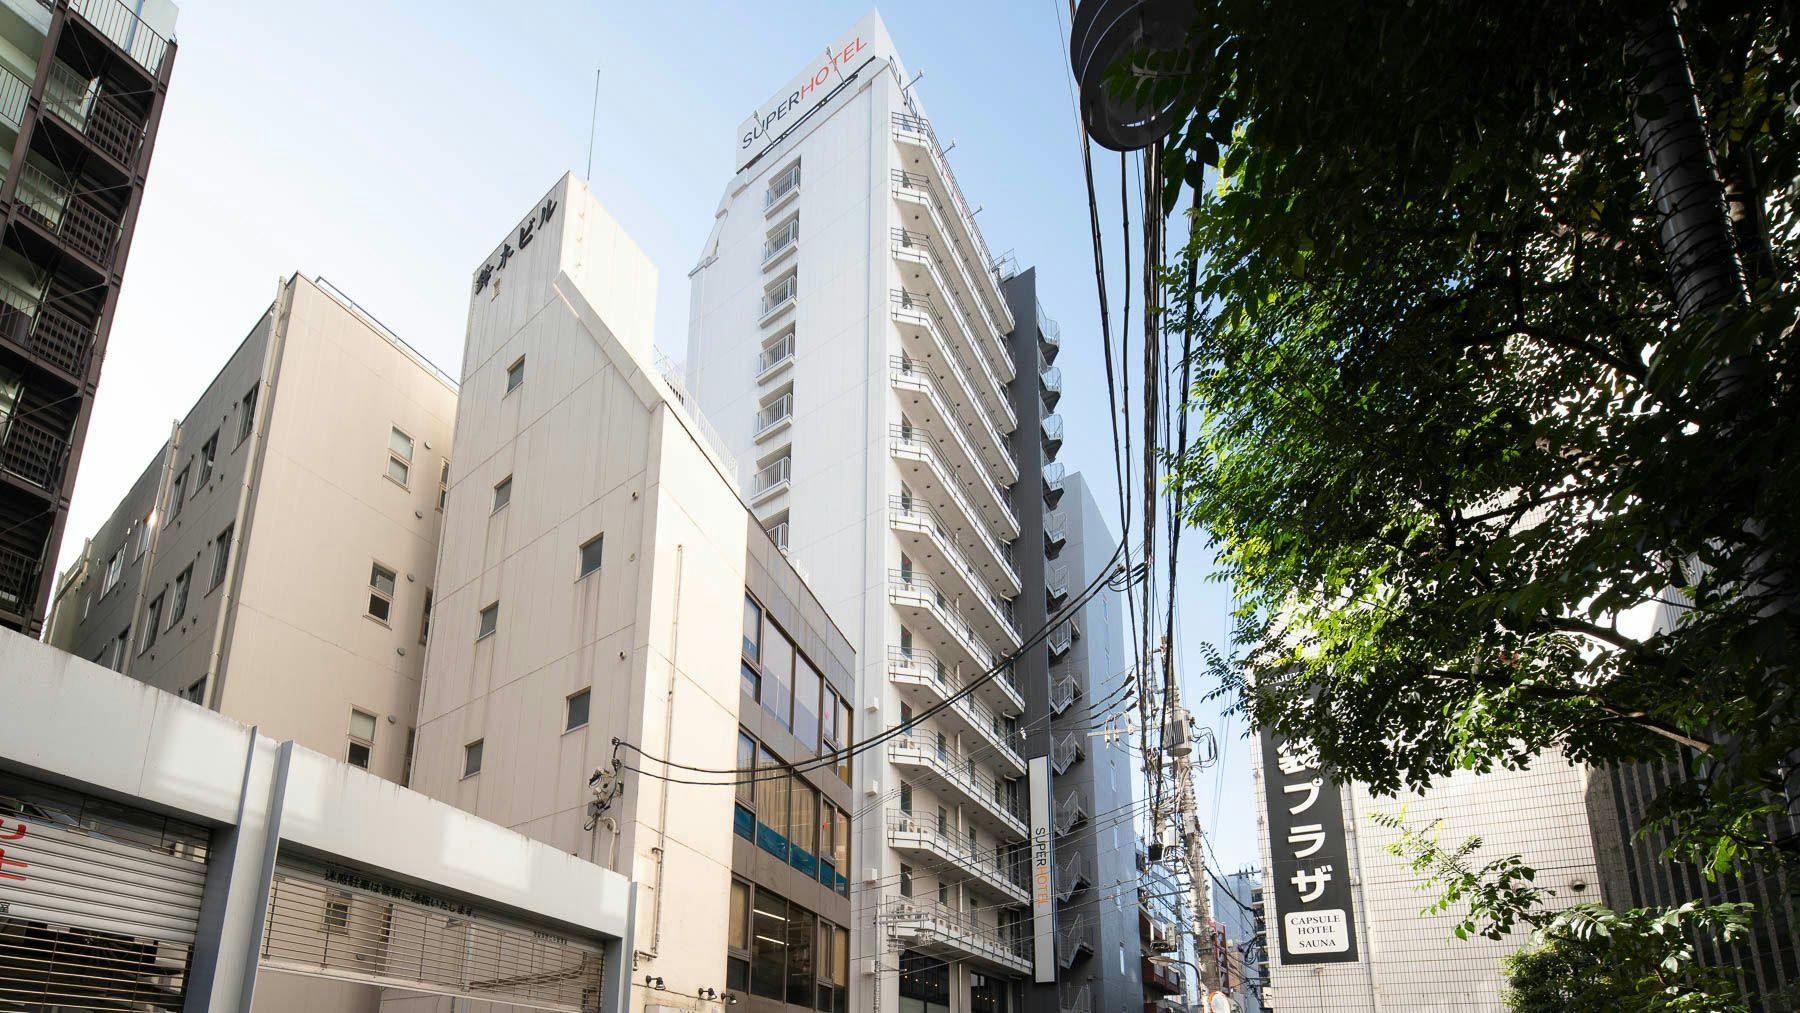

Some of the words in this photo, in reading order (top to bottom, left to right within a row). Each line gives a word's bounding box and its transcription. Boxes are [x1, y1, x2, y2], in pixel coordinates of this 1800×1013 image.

[1291, 915, 1341, 926] CAPSULE
[1298, 926, 1335, 935] HOTEL
[1299, 939, 1336, 948] SAUNA
